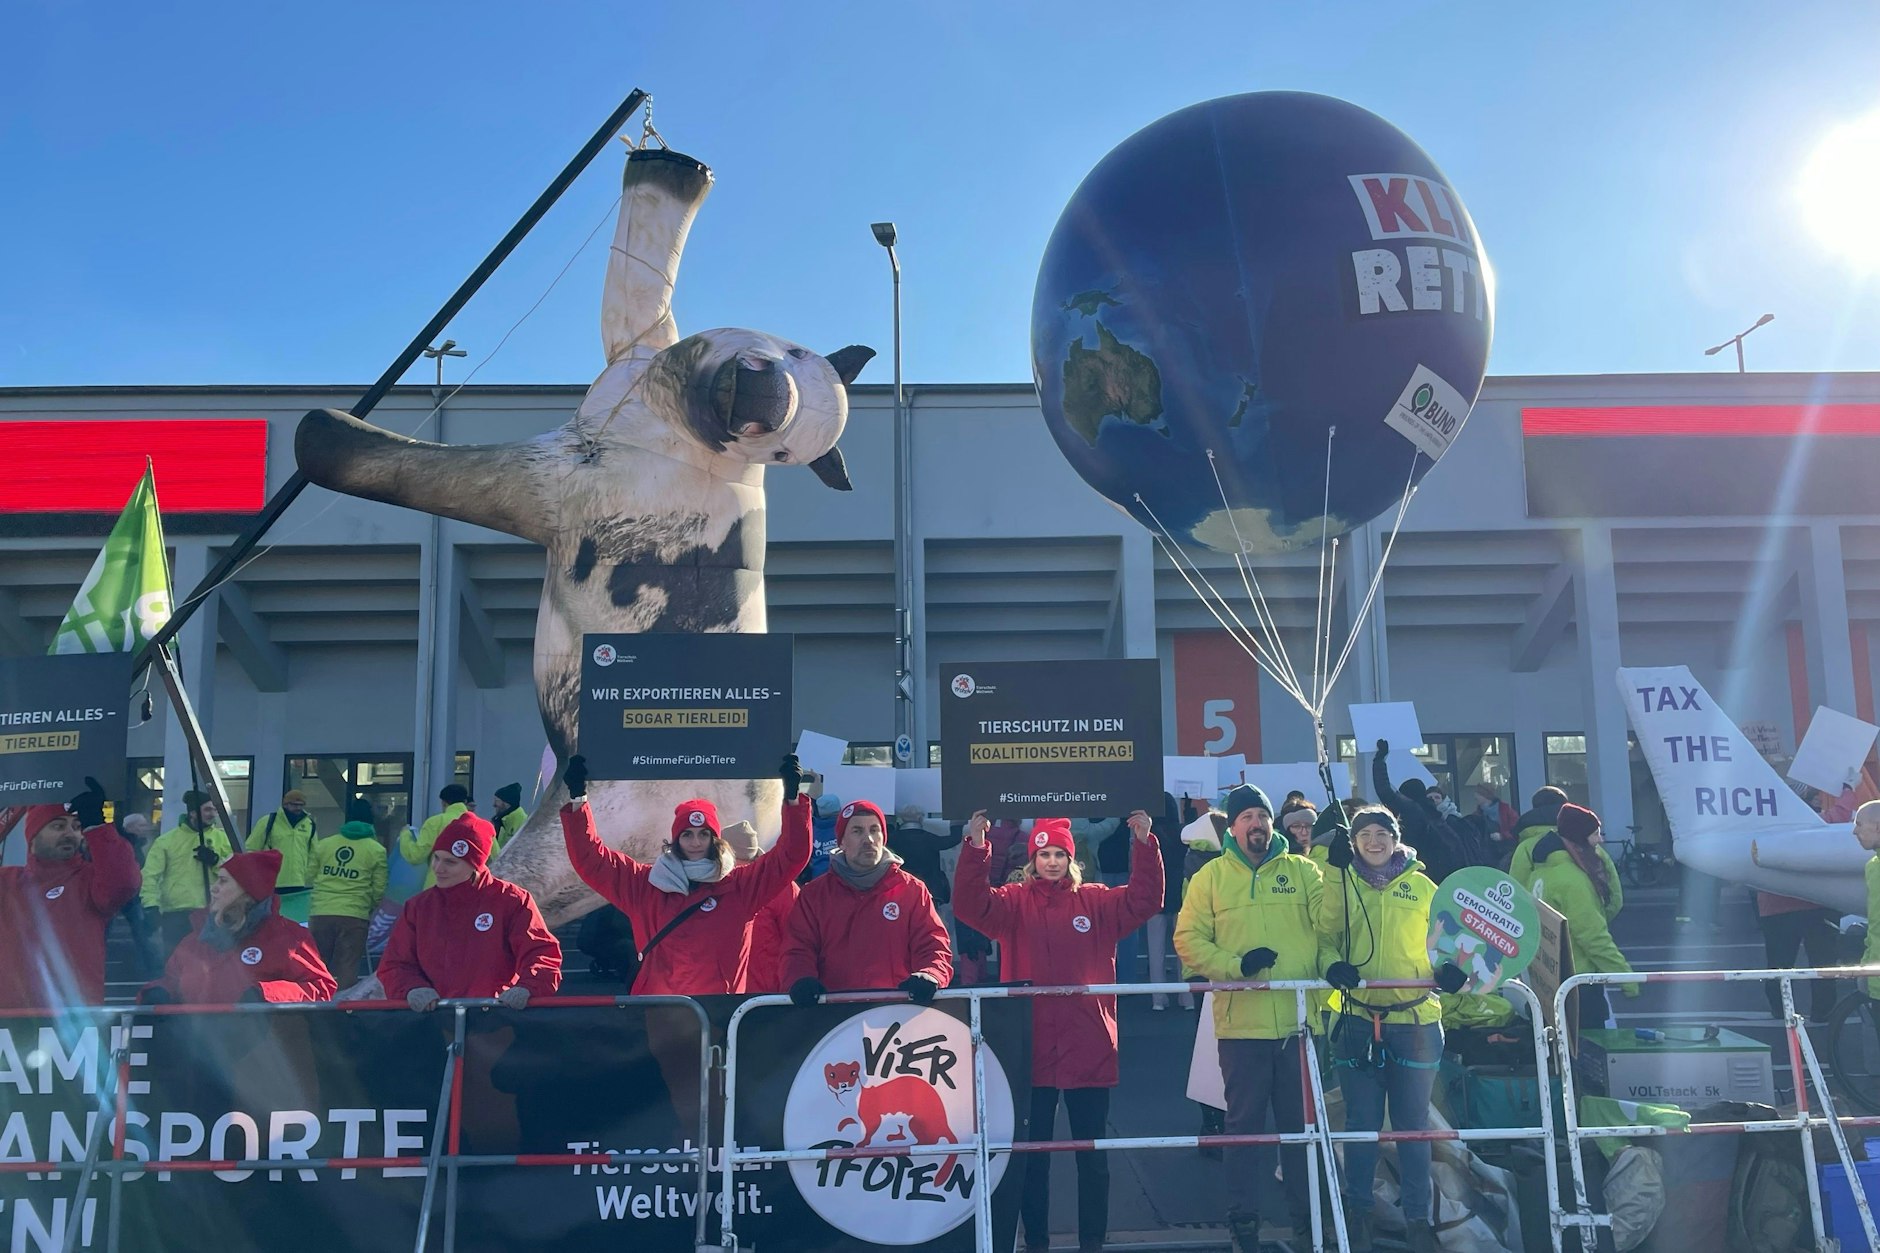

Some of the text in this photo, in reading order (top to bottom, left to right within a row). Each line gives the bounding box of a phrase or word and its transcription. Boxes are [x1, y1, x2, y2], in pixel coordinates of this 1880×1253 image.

[1424, 401, 1456, 435] BUND
[592, 688, 619, 700] WIR
[623, 687, 721, 700] EXPORTIEREN
[725, 687, 769, 700] ALLES
[1637, 686, 1702, 712] TAX
[56, 708, 103, 723] ALLES
[625, 712, 746, 724] SOGAR TIERLEID!
[979, 718, 1124, 734] TIERSCHUTZ IN DEN
[1204, 699, 1237, 754] 5
[5, 734, 77, 750] TIERLEID!
[1664, 735, 1733, 763] THE
[632, 754, 736, 765] #StimmeFürDieTiere
[972, 744, 1132, 761] KOALITIONSVERTRAG!
[999, 791, 1107, 803] #StimmeFürDieTiere
[1695, 787, 1778, 817] RICH
[323, 865, 360, 880] BUND
[1271, 886, 1296, 894] BUND
[1392, 890, 1418, 902] BUND
[1487, 890, 1512, 910] BUND
[1456, 892, 1521, 935] DEMOKRATIE
[1464, 913, 1515, 955] STÄRKEN
[1628, 1086, 1720, 1097] VOLTstack 5k
[596, 1182, 773, 1220] Weltweit.
